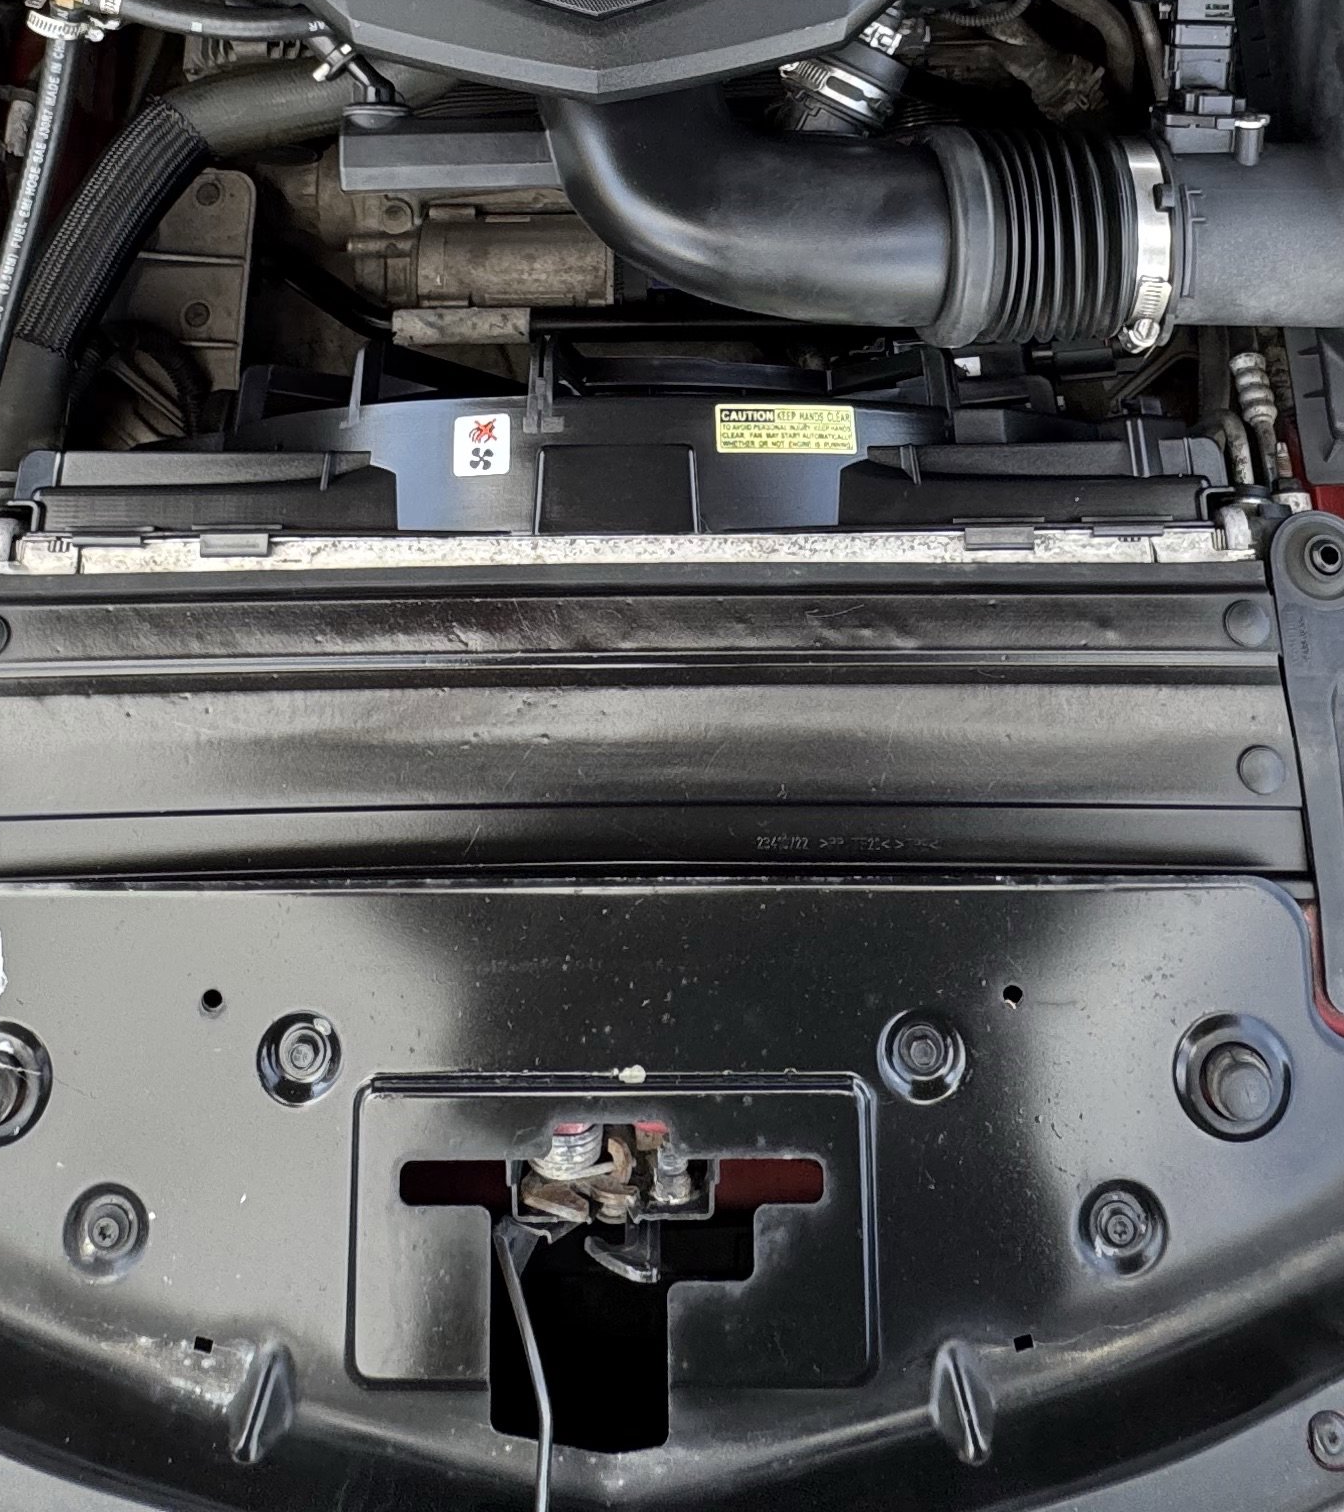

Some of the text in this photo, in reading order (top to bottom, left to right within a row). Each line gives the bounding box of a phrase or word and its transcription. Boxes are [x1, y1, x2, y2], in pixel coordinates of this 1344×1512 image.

[51, 62, 61, 74] IN
[46, 76, 59, 107] MADE
[34, 141, 45, 164] SAE
[26, 165, 40, 197] HOSE
[13, 220, 26, 250] FUEL
[721, 410, 850, 422] CAUTION KEEP HANDS CLEAR
